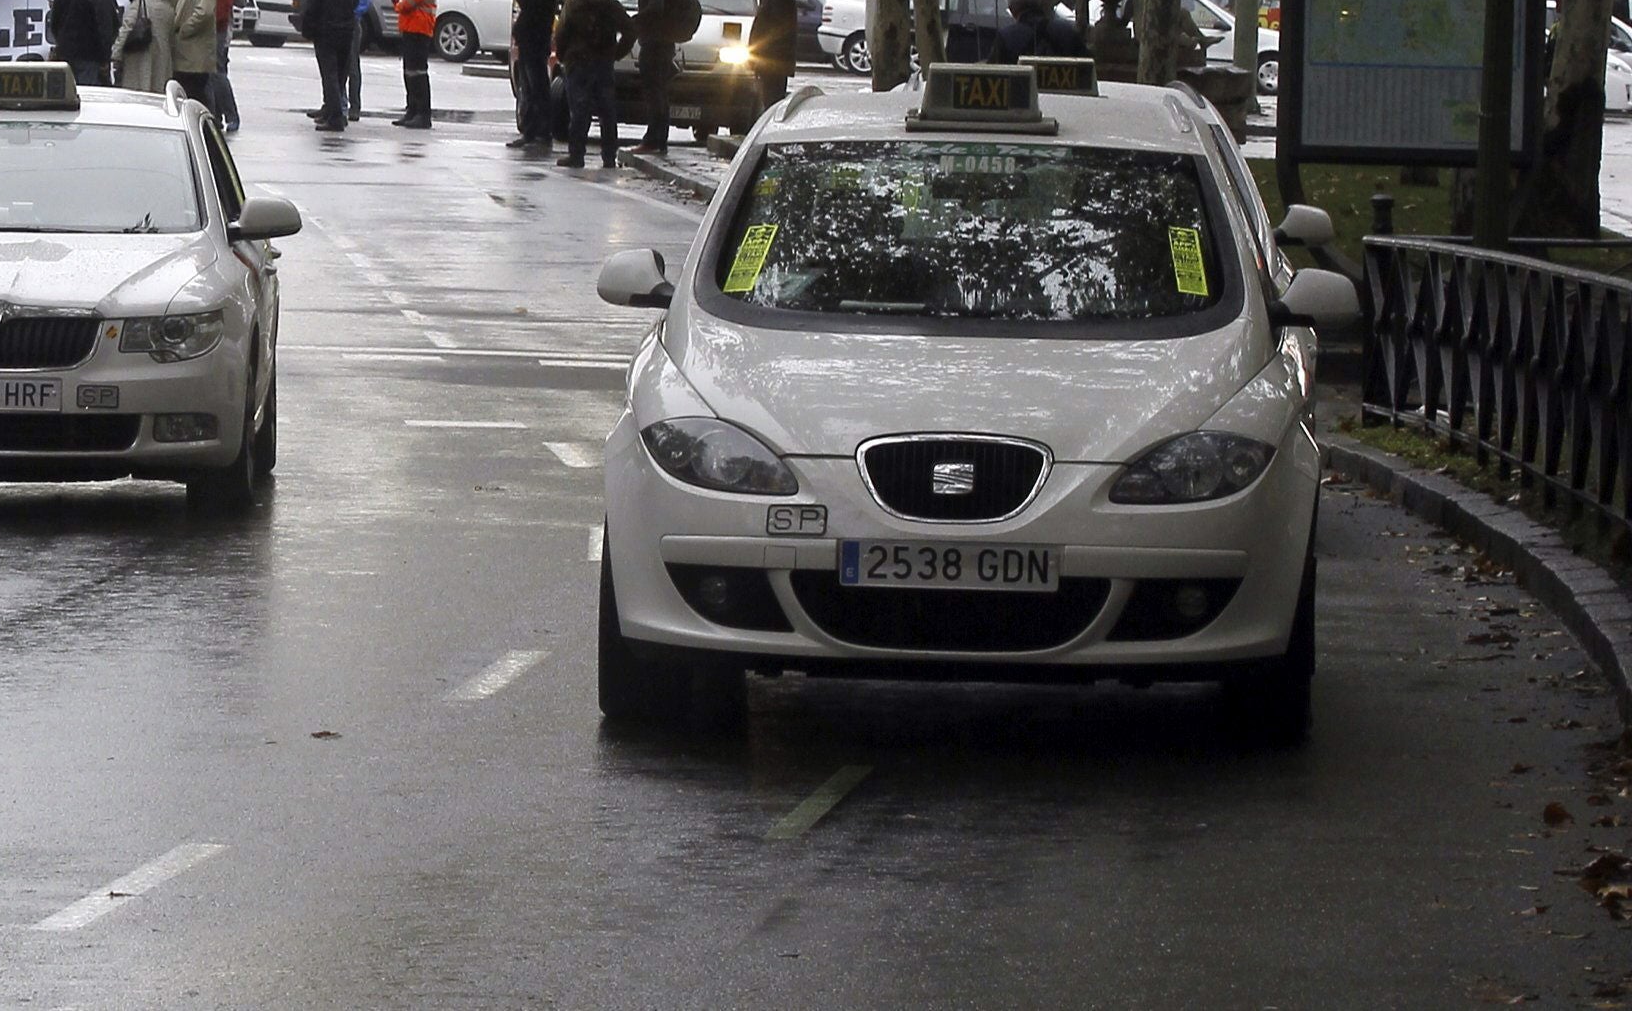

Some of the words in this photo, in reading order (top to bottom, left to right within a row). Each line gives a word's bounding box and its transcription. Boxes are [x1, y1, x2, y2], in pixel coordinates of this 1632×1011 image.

[1, 74, 43, 97] TAXI
[1038, 66, 1077, 87] TAXI
[954, 76, 1009, 107] TAXI
[939, 155, 1016, 175] M-0458
[4, 382, 55, 407] HRF
[81, 389, 114, 404] SP
[773, 509, 820, 530] SP
[868, 545, 963, 581] 2538
[977, 548, 1049, 584] GDN
